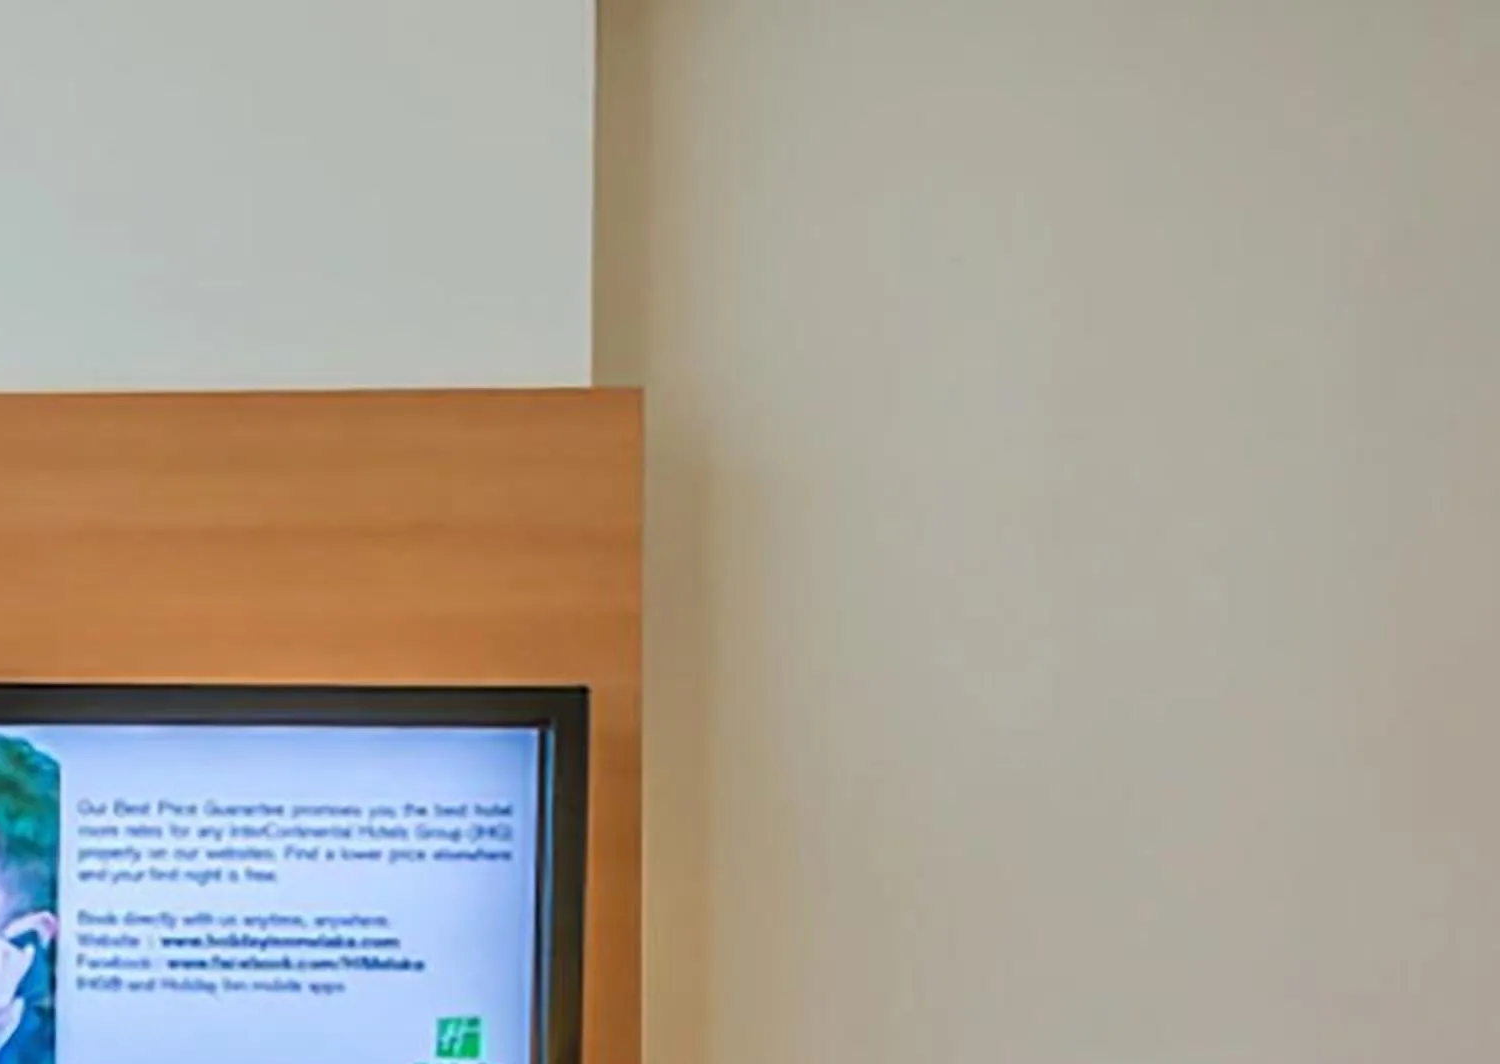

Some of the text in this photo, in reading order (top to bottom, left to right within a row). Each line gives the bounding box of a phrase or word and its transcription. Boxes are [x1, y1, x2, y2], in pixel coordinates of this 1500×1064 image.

[113, 800, 149, 817] Best
[158, 800, 197, 817] Price
[369, 804, 396, 822] you
[404, 802, 427, 819] the
[434, 803, 468, 819] best
[169, 822, 189, 838] for
[197, 825, 224, 842] any
[149, 849, 167, 860] on
[326, 850, 335, 861] a
[77, 868, 108, 882] and
[182, 912, 214, 926] with
